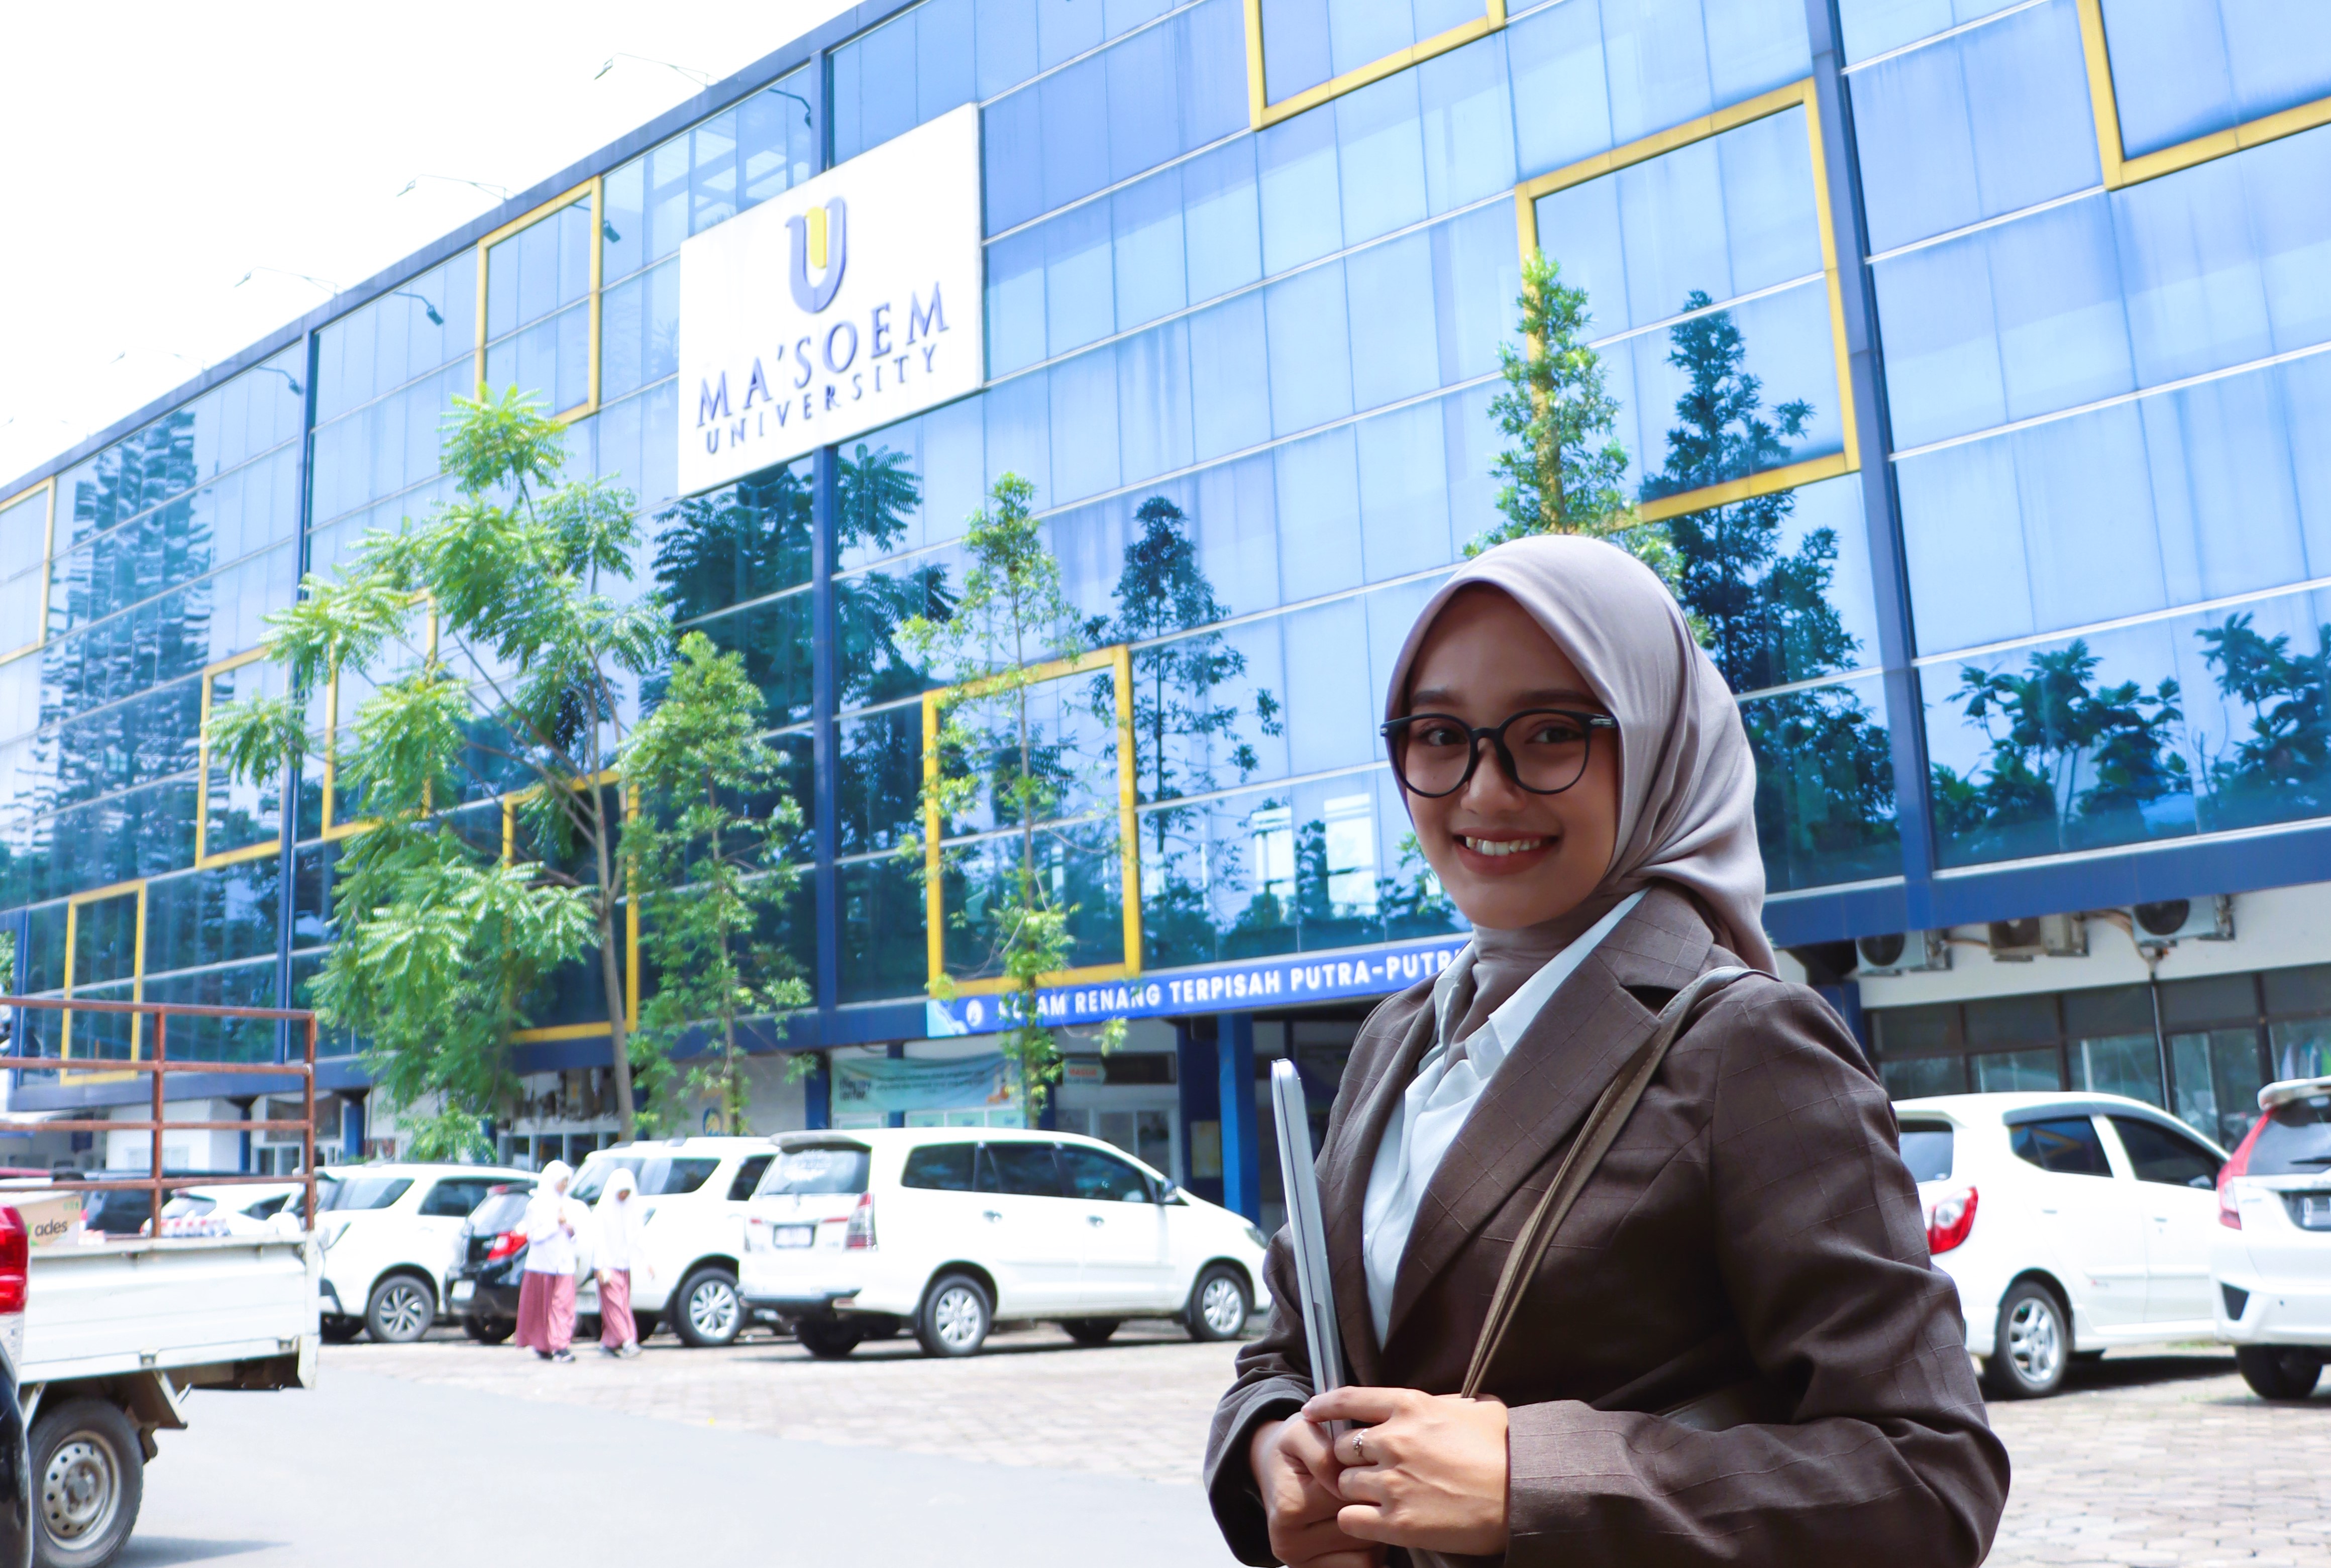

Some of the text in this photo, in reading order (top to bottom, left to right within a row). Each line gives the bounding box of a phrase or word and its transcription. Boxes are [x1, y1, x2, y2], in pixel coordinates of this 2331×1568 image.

[697, 280, 949, 428] MA'SOEM
[706, 343, 936, 454] UNIVERSITY
[1075, 983, 1160, 1013] RENANG
[1169, 970, 1280, 1003] TERPISAH
[1290, 948, 1460, 991] PUTRA-PUTR
[34, 1218, 67, 1237] ades
